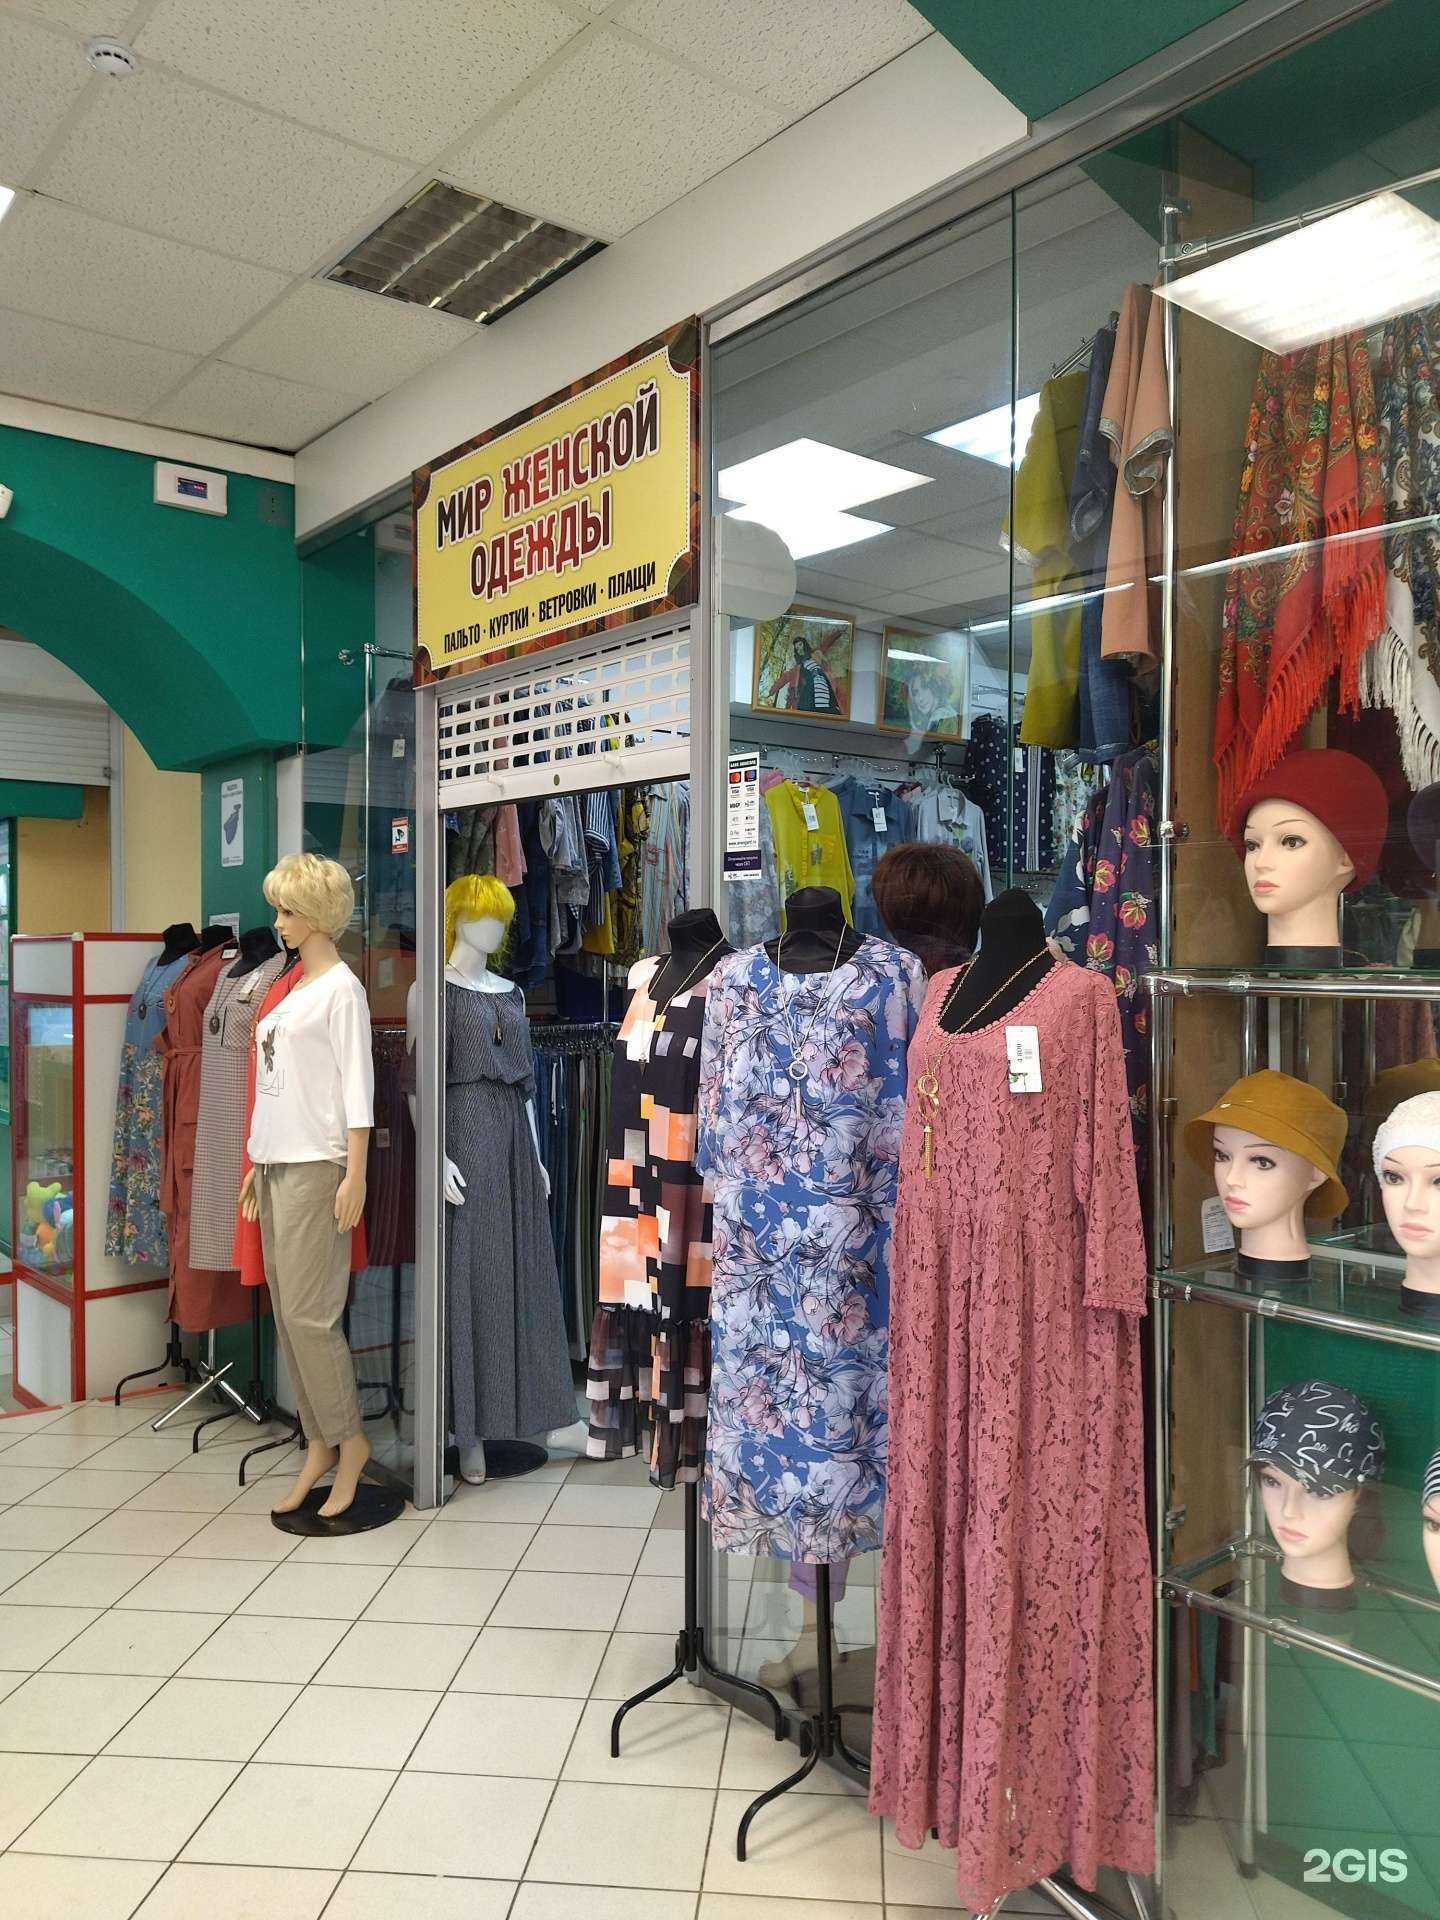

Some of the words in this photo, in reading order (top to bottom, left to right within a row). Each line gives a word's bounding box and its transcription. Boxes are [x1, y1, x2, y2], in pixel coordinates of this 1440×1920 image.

[437, 477, 492, 549] МИР
[502, 382, 658, 519] ЖЕНСКОЙ
[470, 490, 611, 600] ОДЕЖДЫ
[444, 623, 481, 654] ПАЛЬТО
[489, 607, 529, 639] КУРТКИ
[539, 582, 597, 622] ВЕТРОВКИ
[608, 561, 656, 600] ПЛАЩИ
